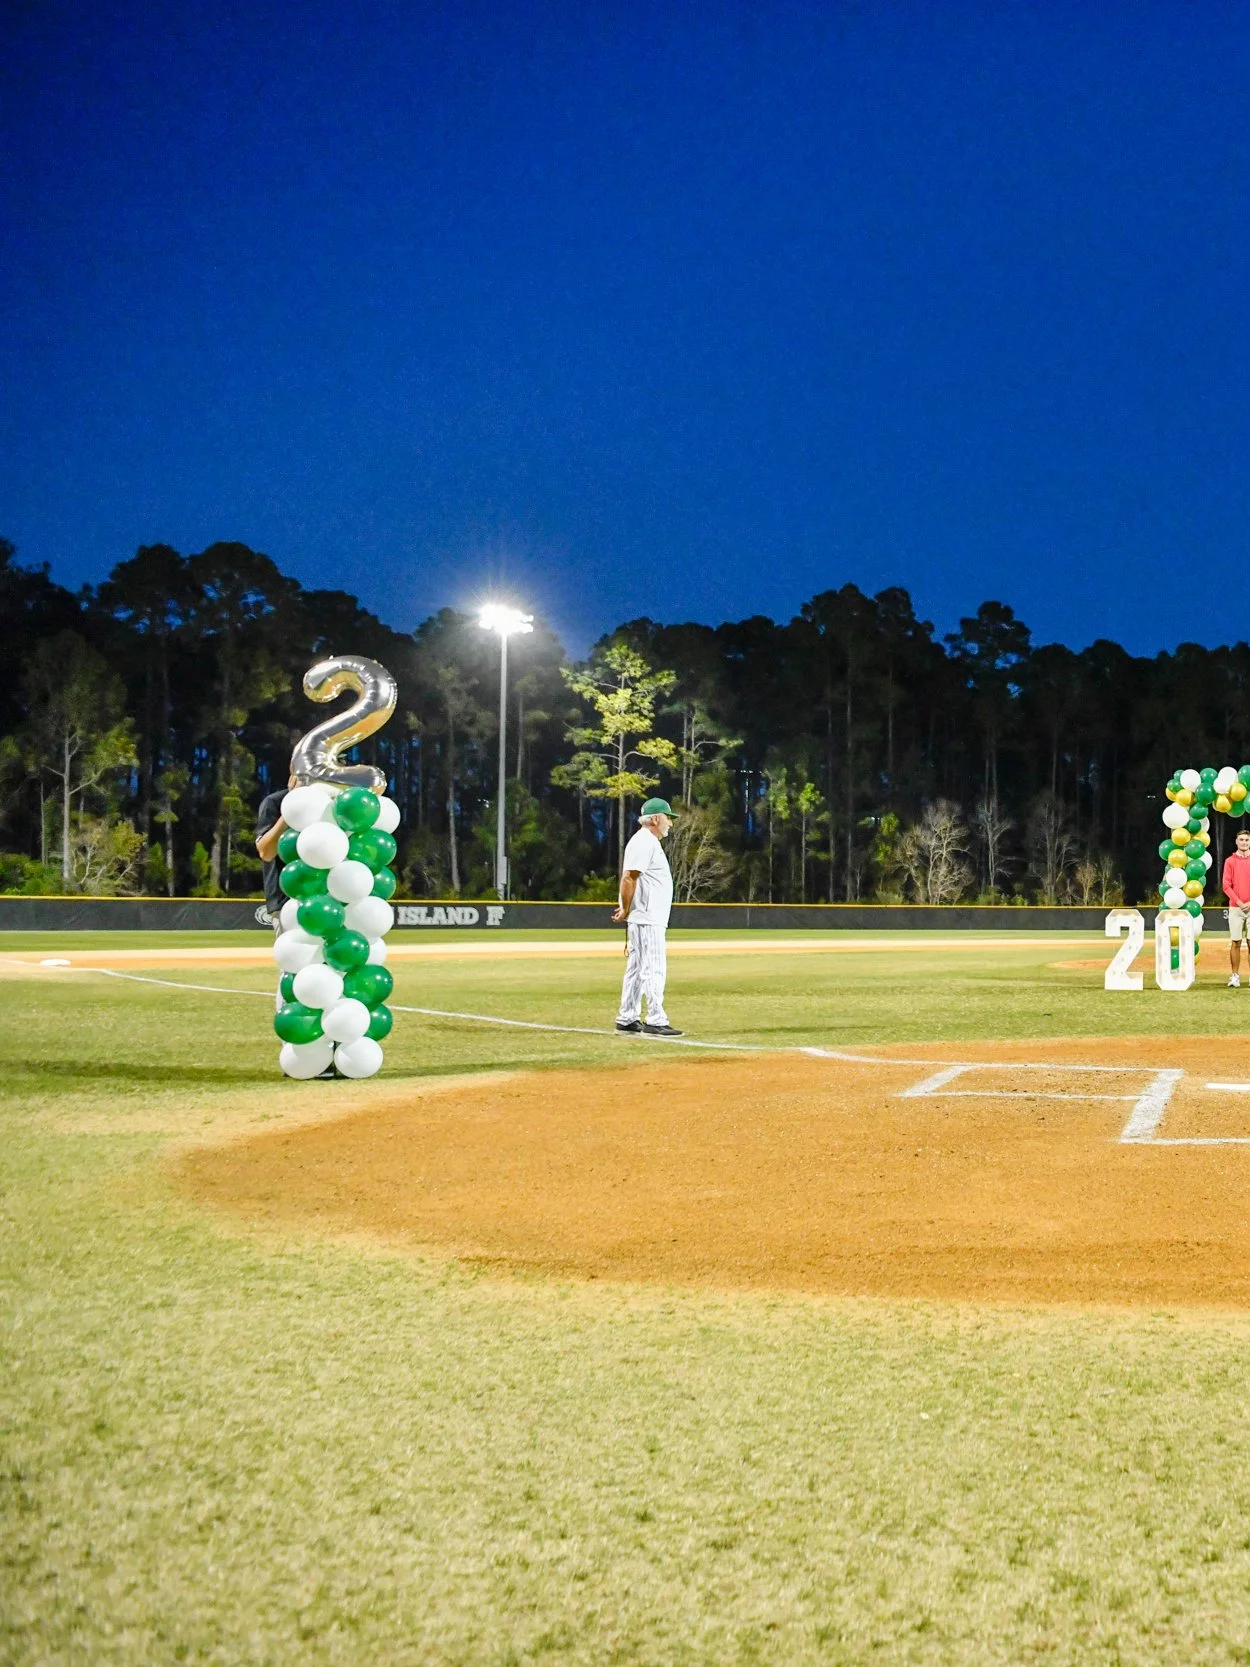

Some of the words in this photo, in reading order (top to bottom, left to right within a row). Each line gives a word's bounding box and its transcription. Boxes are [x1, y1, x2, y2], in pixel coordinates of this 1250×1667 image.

[290, 655, 398, 796] 2
[397, 906, 480, 925] ISLAND
[1104, 909, 1196, 991] 20
